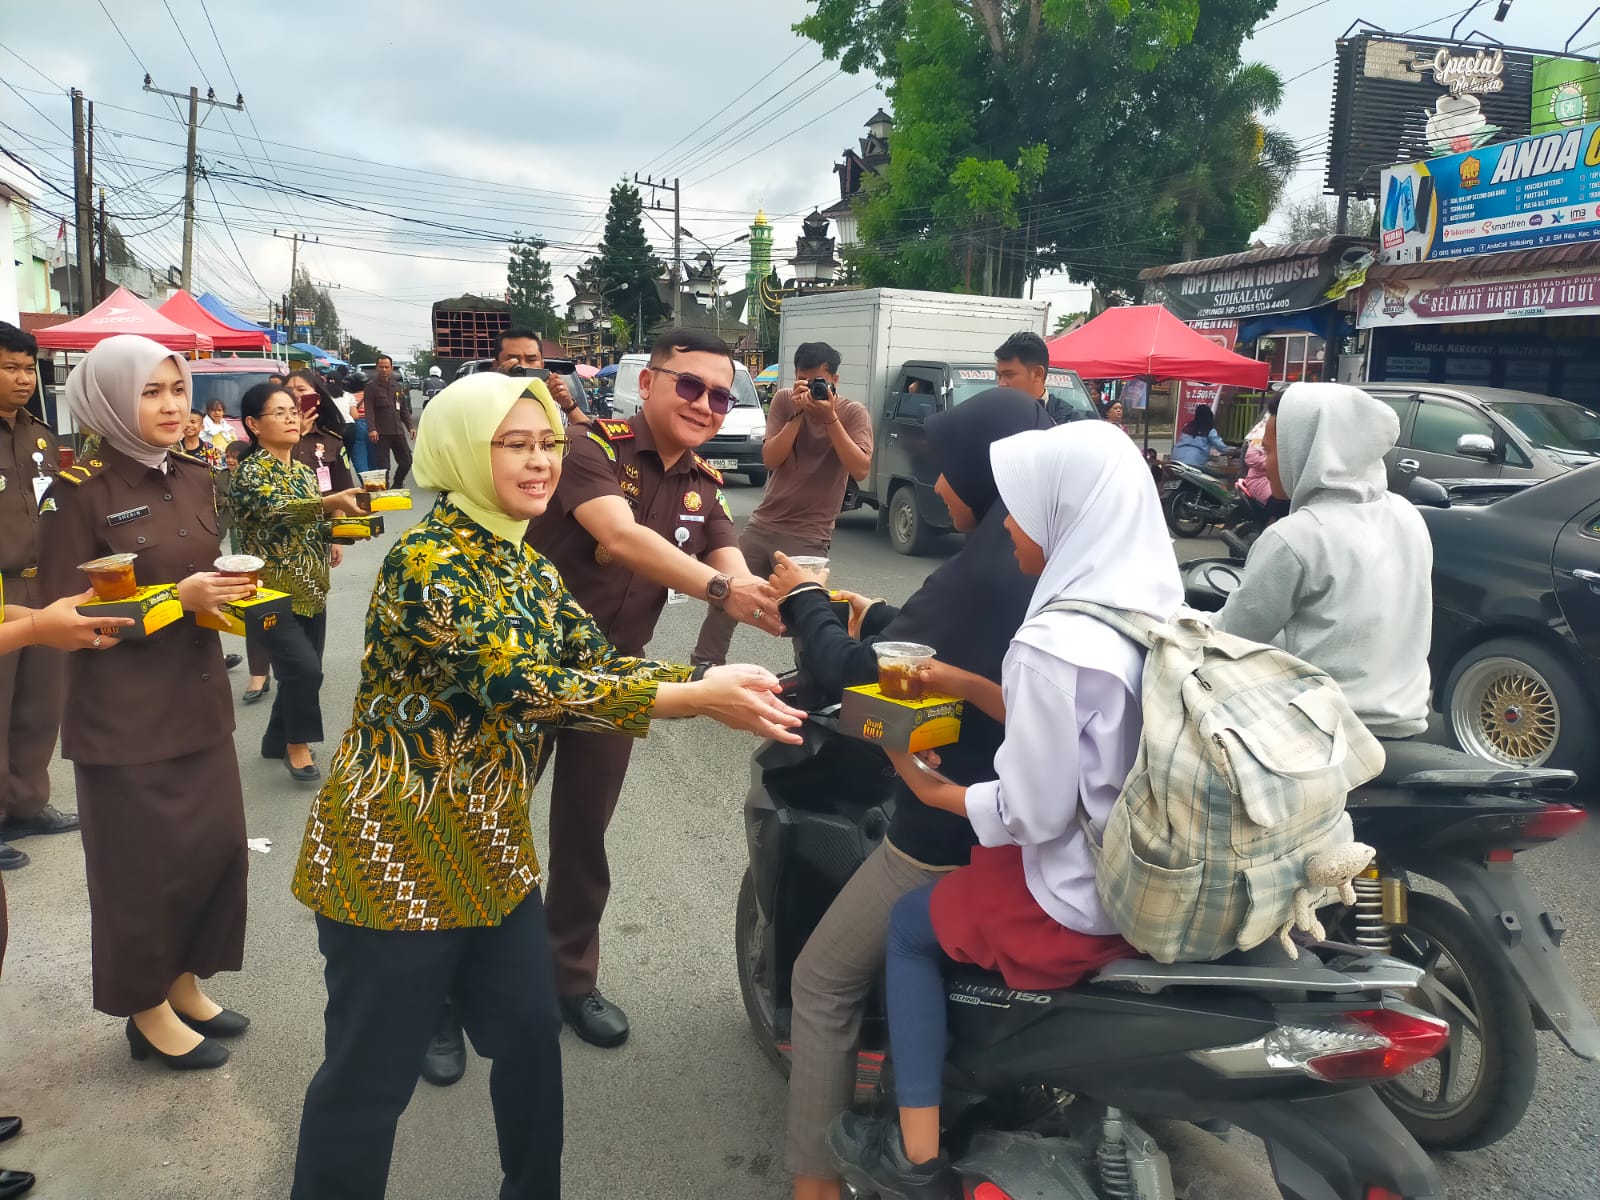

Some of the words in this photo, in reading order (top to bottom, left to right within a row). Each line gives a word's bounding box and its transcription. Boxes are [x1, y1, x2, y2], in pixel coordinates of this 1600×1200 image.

[1490, 128, 1583, 185] ANDA
[1490, 219, 1526, 232] smartfren
[1256, 257, 1320, 286] ROBUSTA
[1454, 287, 1485, 295] SELAMAT
[1488, 282, 1538, 292] MENUNAIKAN
[1213, 287, 1274, 307] SIDIKALANG
[1431, 293, 1482, 313] SELAMAT
[1486, 290, 1517, 309] HARI
[1523, 287, 1555, 307] RAYA
[1561, 283, 1594, 303] IDUL
[960, 370, 995, 380] MAJU
[1047, 373, 1071, 382] TOR
[1015, 991, 1052, 1004] 150
